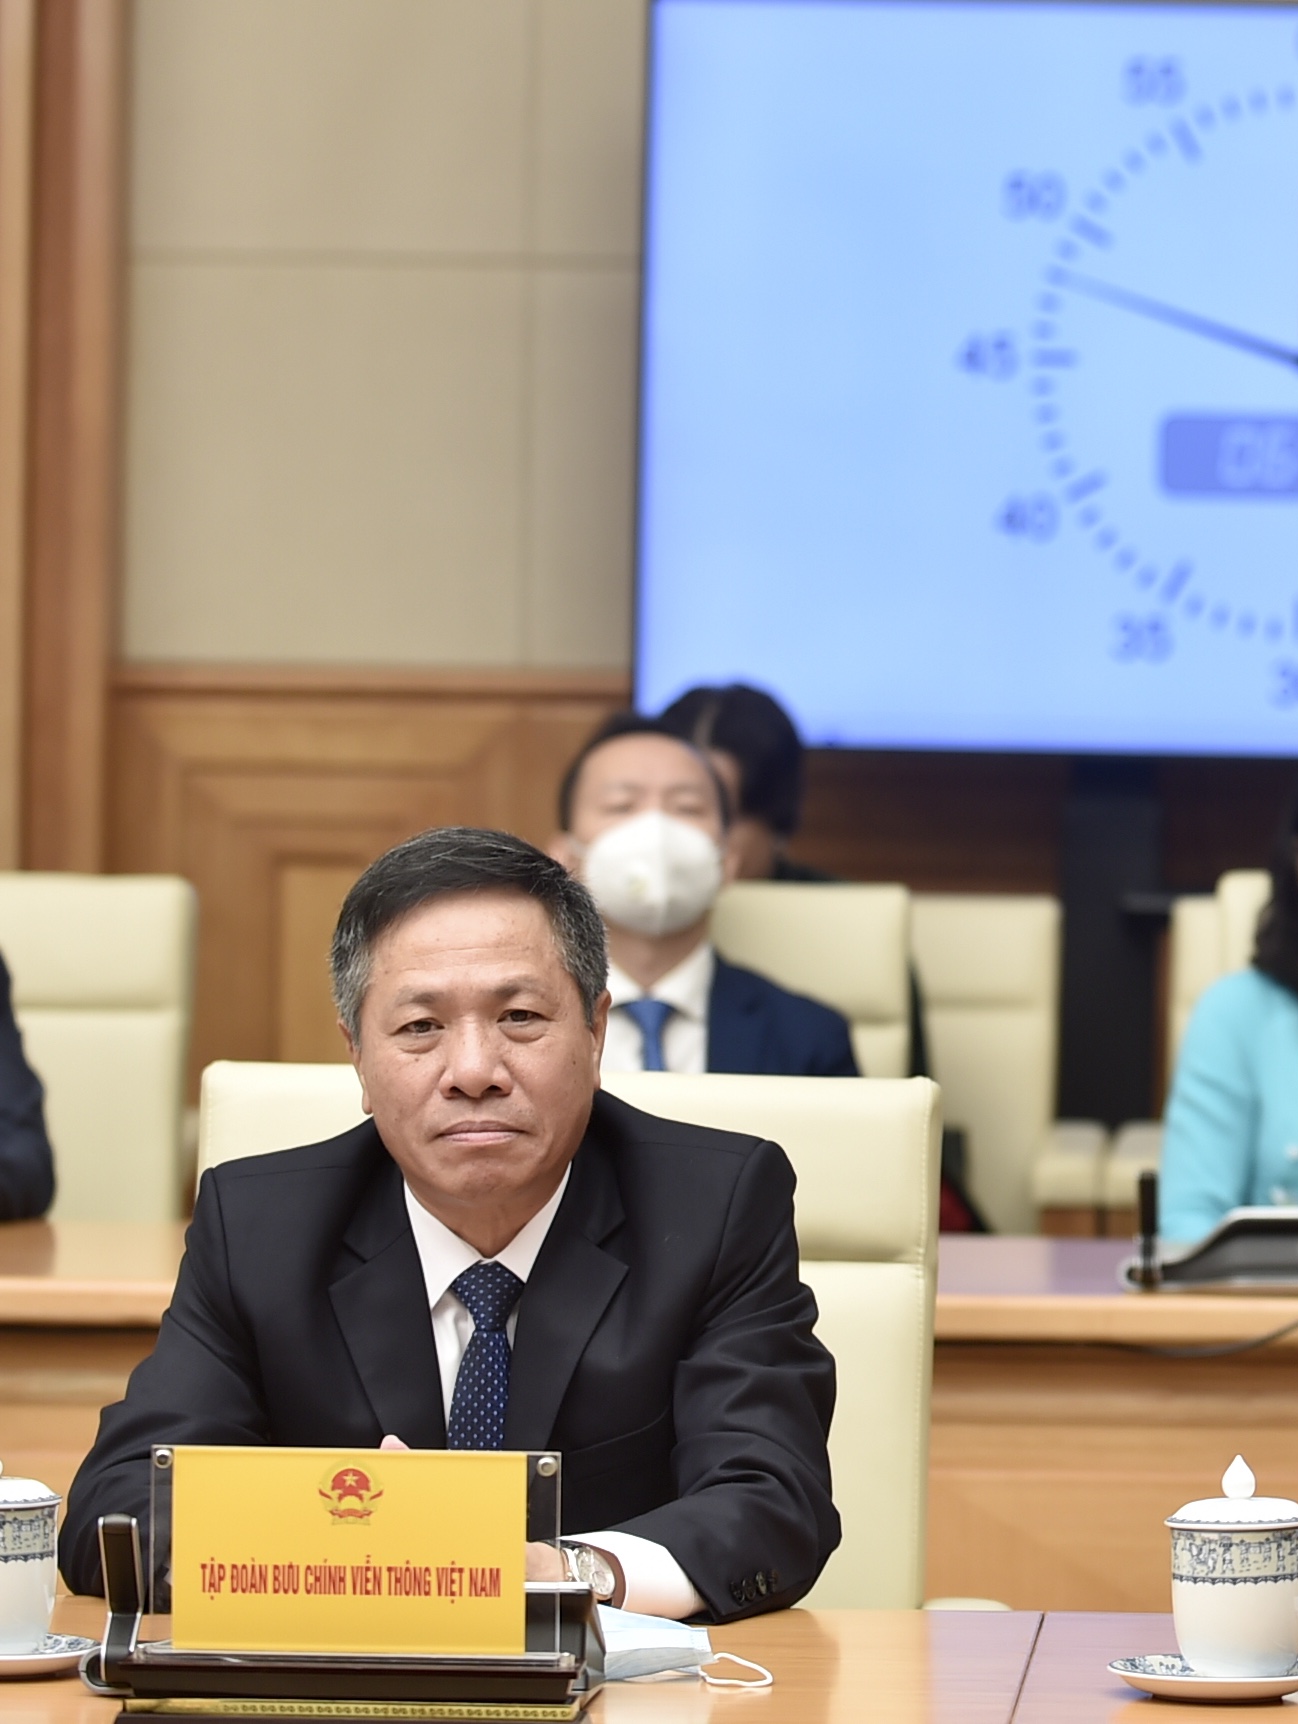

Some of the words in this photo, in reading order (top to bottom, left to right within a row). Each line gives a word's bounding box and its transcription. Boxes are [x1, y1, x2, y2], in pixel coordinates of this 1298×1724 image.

[1122, 54, 1186, 107] 55
[1001, 169, 1067, 222] 50
[956, 329, 1018, 381] 45
[995, 492, 1059, 543] 40
[1110, 612, 1173, 664] 35
[201, 1557, 225, 1601] TẬP
[231, 1558, 267, 1594] ĐOÀN
[273, 1562, 300, 1595] BƯU
[305, 1558, 346, 1595] CHÍNH
[351, 1554, 381, 1596] VIỄN
[387, 1560, 431, 1597] THÔNG
[436, 1560, 464, 1604] VIỆT
[469, 1567, 501, 1598] NAM
